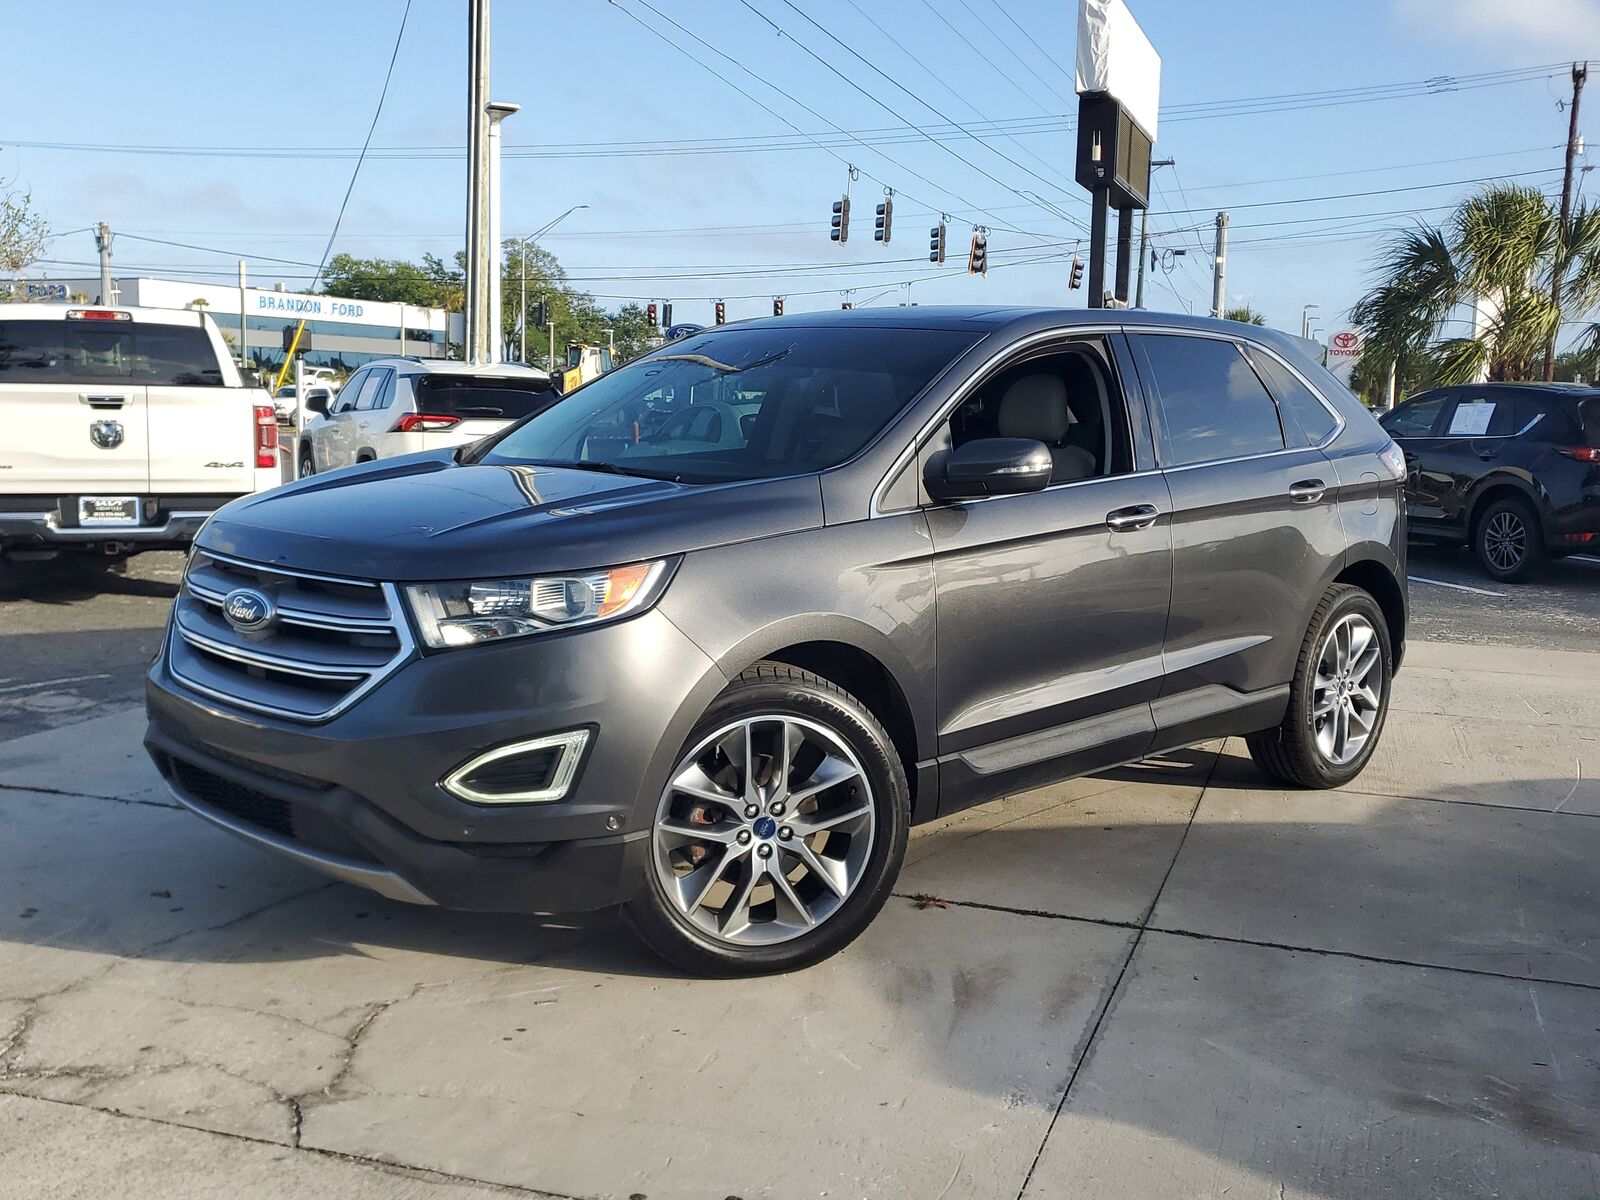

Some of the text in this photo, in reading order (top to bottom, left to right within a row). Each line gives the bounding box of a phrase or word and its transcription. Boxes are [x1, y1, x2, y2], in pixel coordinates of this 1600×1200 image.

[259, 296, 364, 317] BRANDON FORD
[230, 595, 258, 620] Ford
